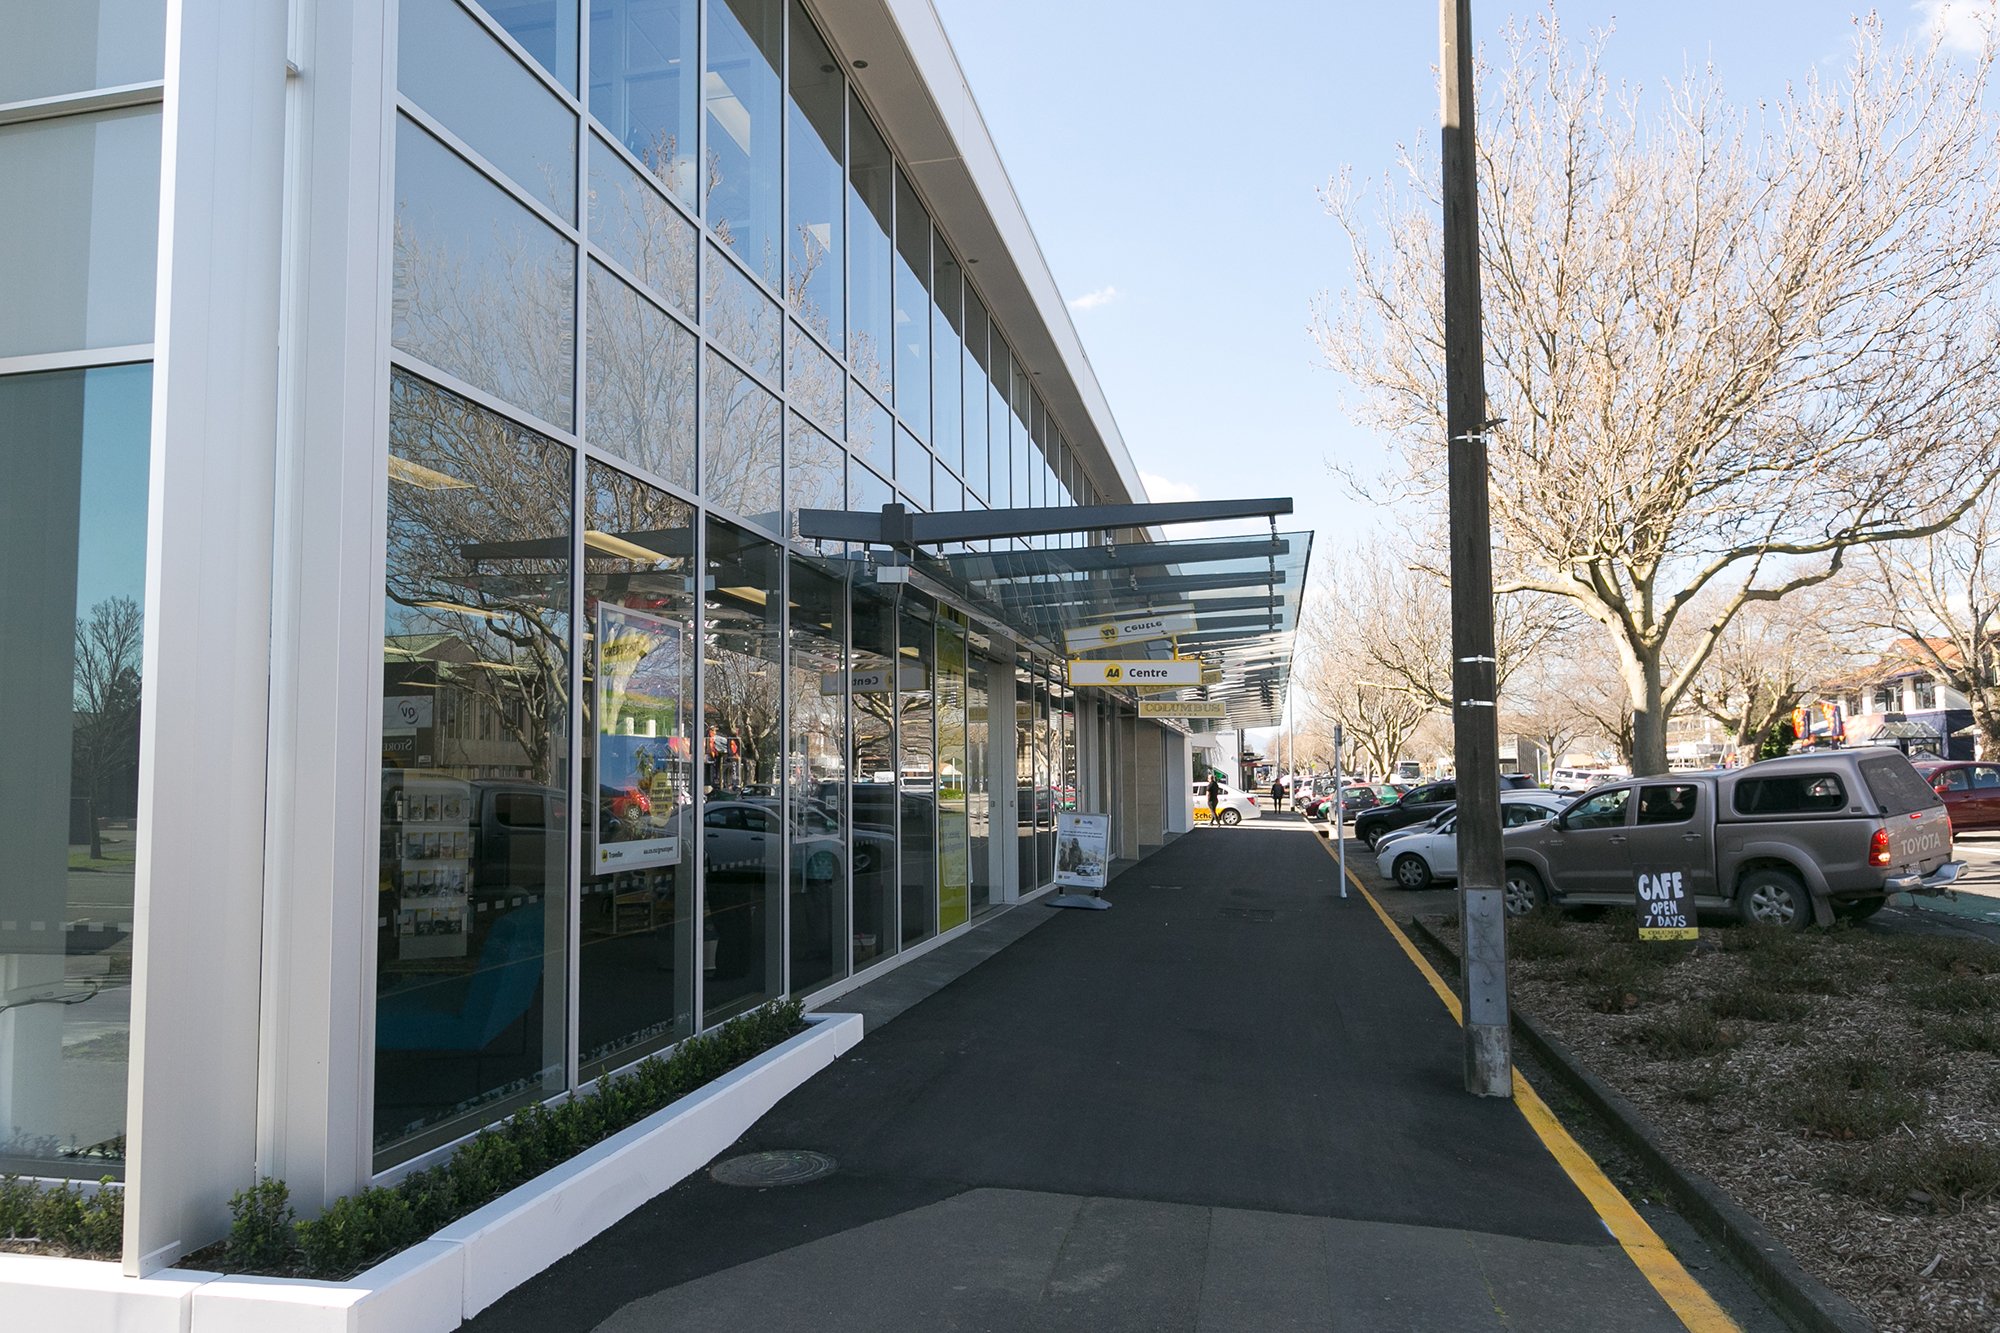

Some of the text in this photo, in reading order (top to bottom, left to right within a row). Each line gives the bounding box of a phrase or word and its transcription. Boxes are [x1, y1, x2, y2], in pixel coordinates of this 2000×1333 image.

[1106, 668, 1168, 678] AA Centre
[1145, 703, 1220, 712] COLUMBUS
[1901, 832, 1941, 855] TOYOTA
[1638, 871, 1684, 900] CAFE
[1650, 900, 1678, 915] OPEN
[1644, 915, 1687, 927] 7 DAYS
